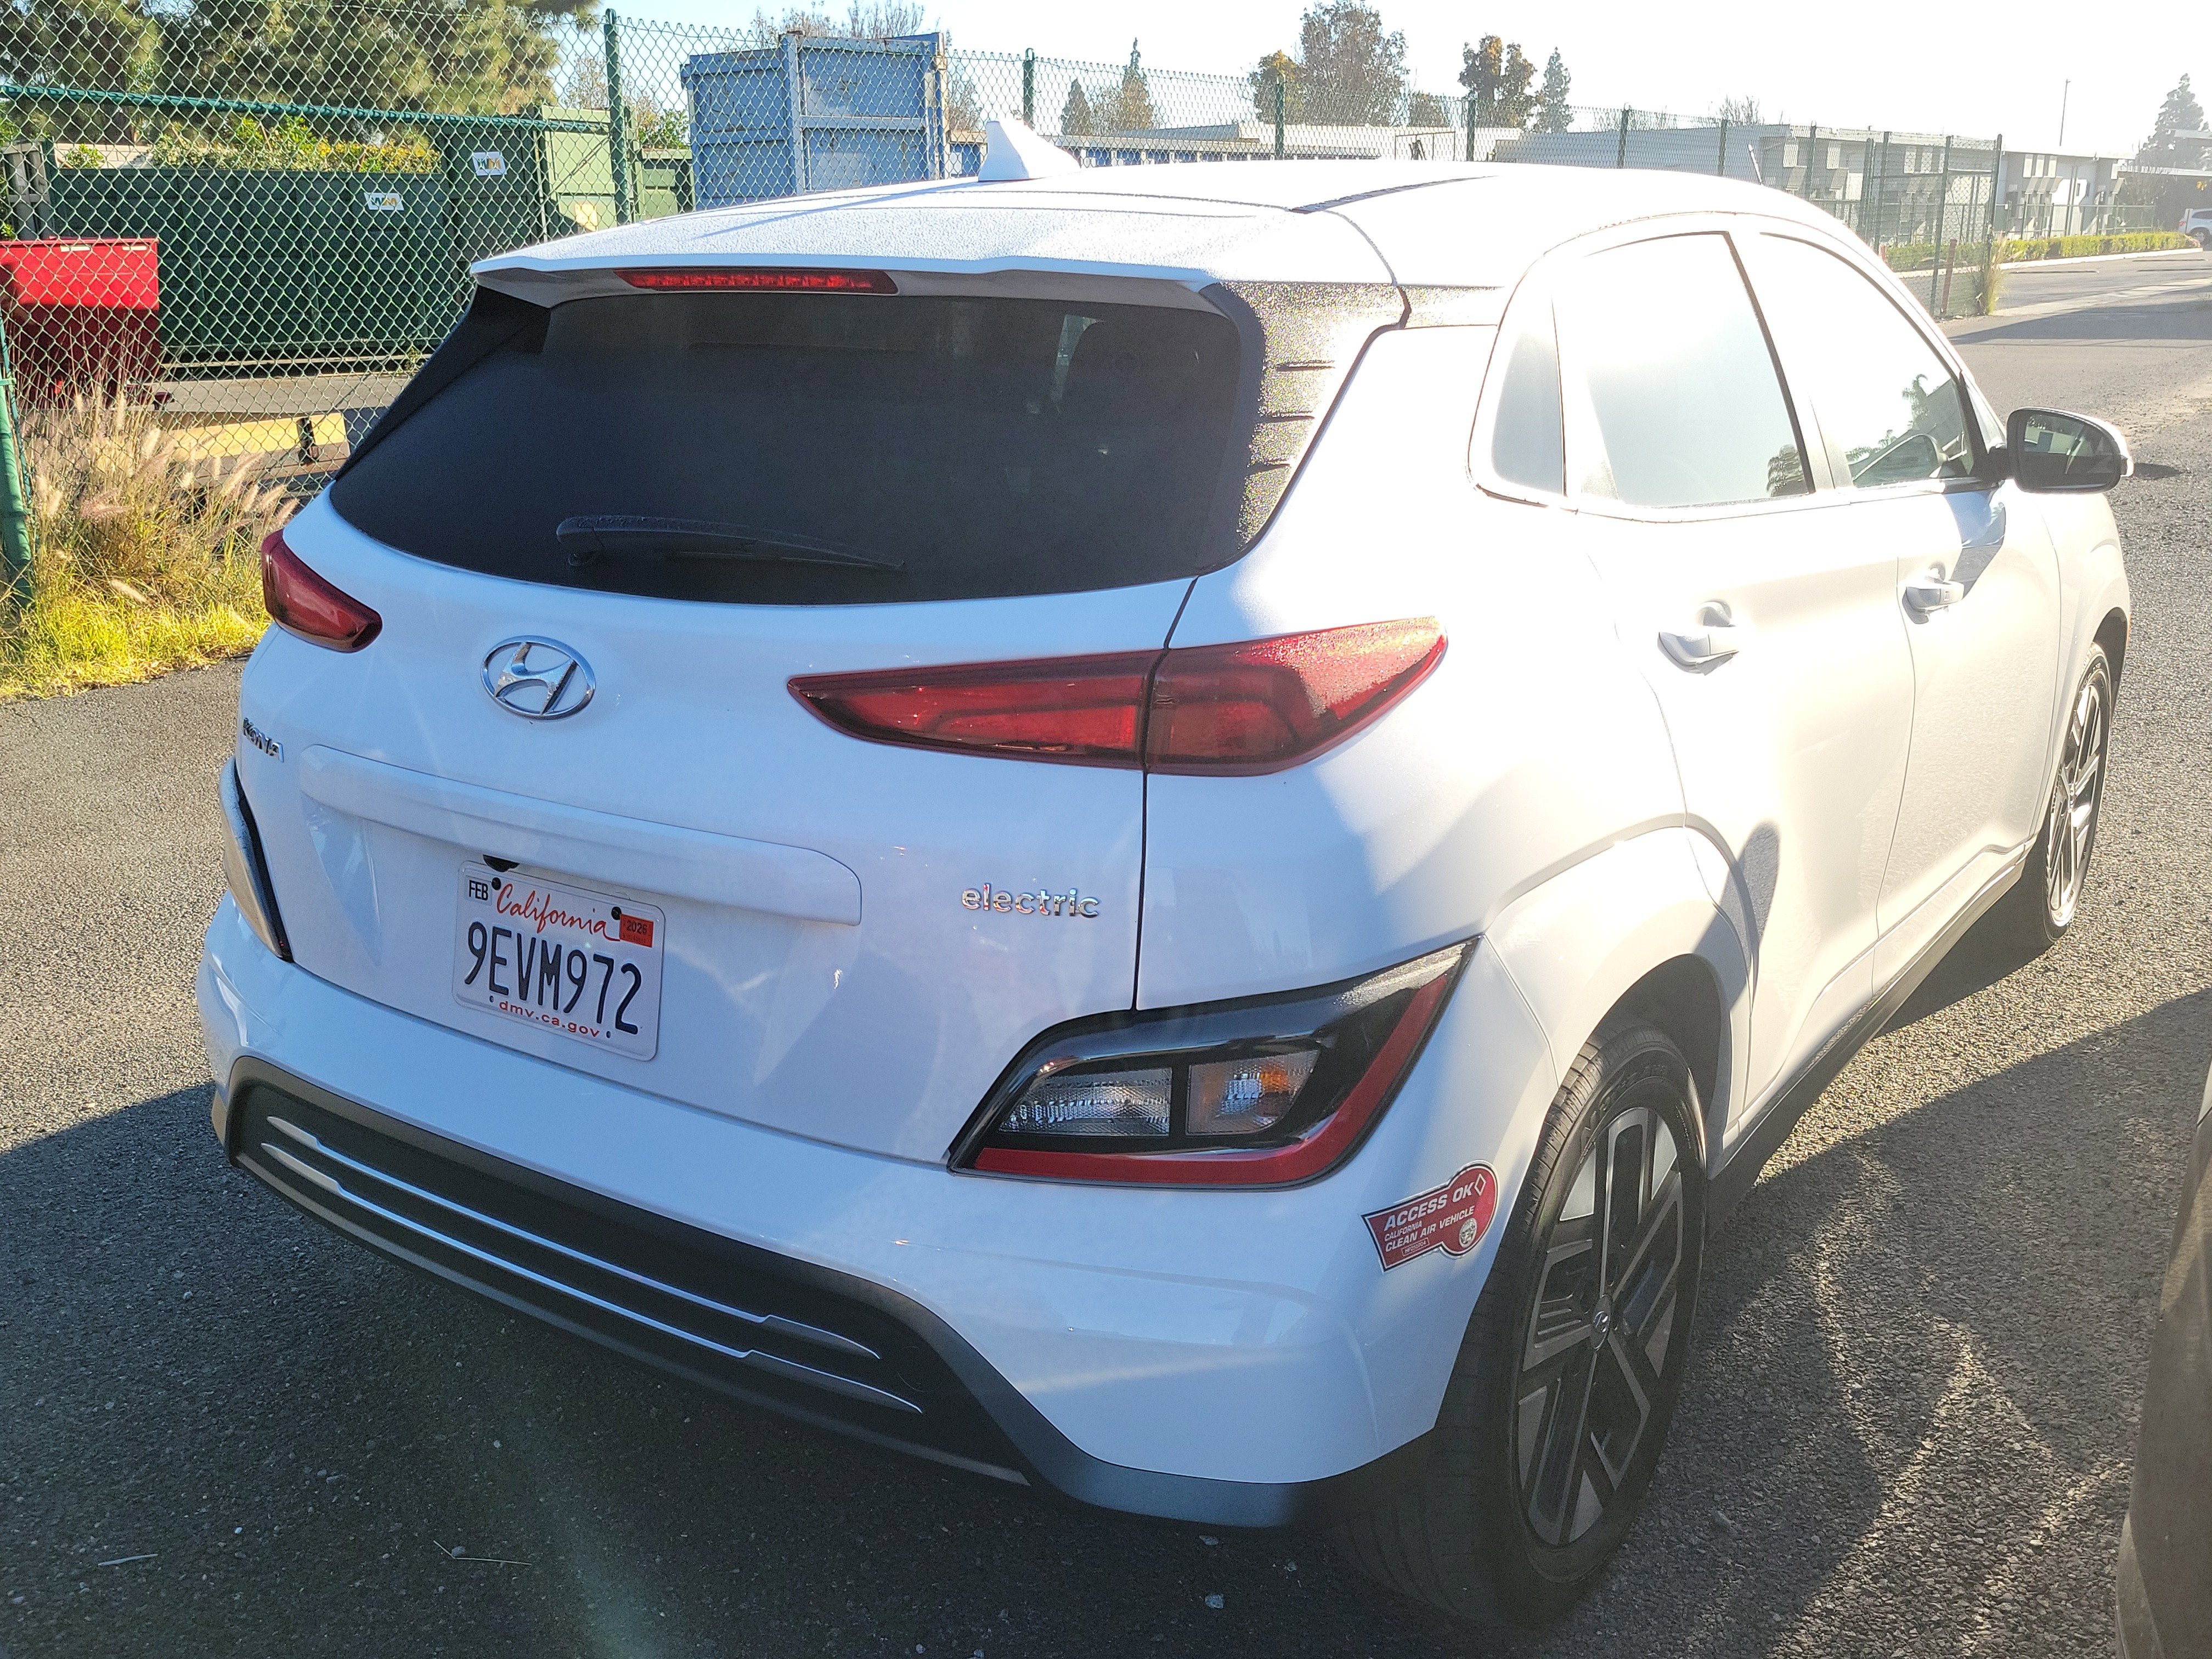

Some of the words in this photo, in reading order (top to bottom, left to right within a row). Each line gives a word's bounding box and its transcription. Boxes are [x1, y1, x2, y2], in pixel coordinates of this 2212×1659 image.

[469, 879, 489, 901] FEB
[962, 882, 1099, 918] electric
[496, 883, 620, 941] California
[627, 920, 647, 935] 2026
[464, 921, 642, 1035] 9EVM972
[499, 1001, 600, 1038] dmv.ca.gov
[1384, 1194, 1448, 1232] ACCESS
[1452, 1182, 1475, 1203] OK
[1384, 1220, 1422, 1242] CALIFORNIA
[1385, 1231, 1418, 1252] CLEAN
[1420, 1223, 1436, 1238] AIR
[1439, 1205, 1475, 1229] VEHICLE
